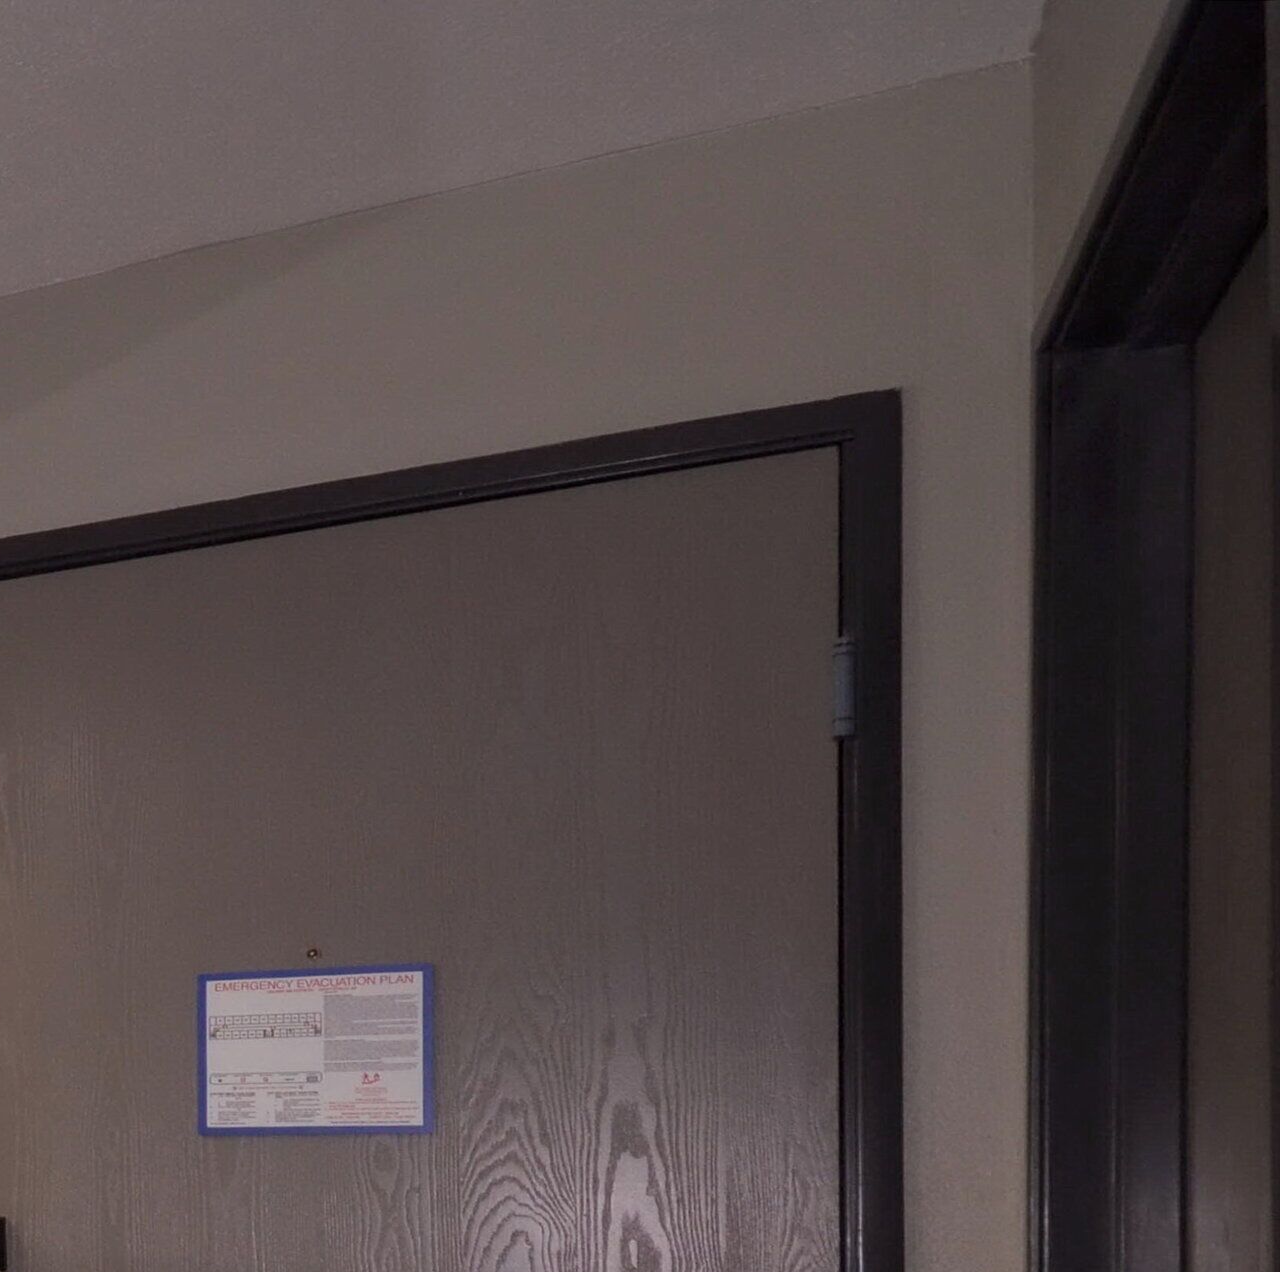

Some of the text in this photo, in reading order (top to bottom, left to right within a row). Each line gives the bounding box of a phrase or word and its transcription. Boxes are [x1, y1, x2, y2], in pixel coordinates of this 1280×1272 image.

[214, 974, 414, 993] EMERGENCY EVACUATION PLAN
